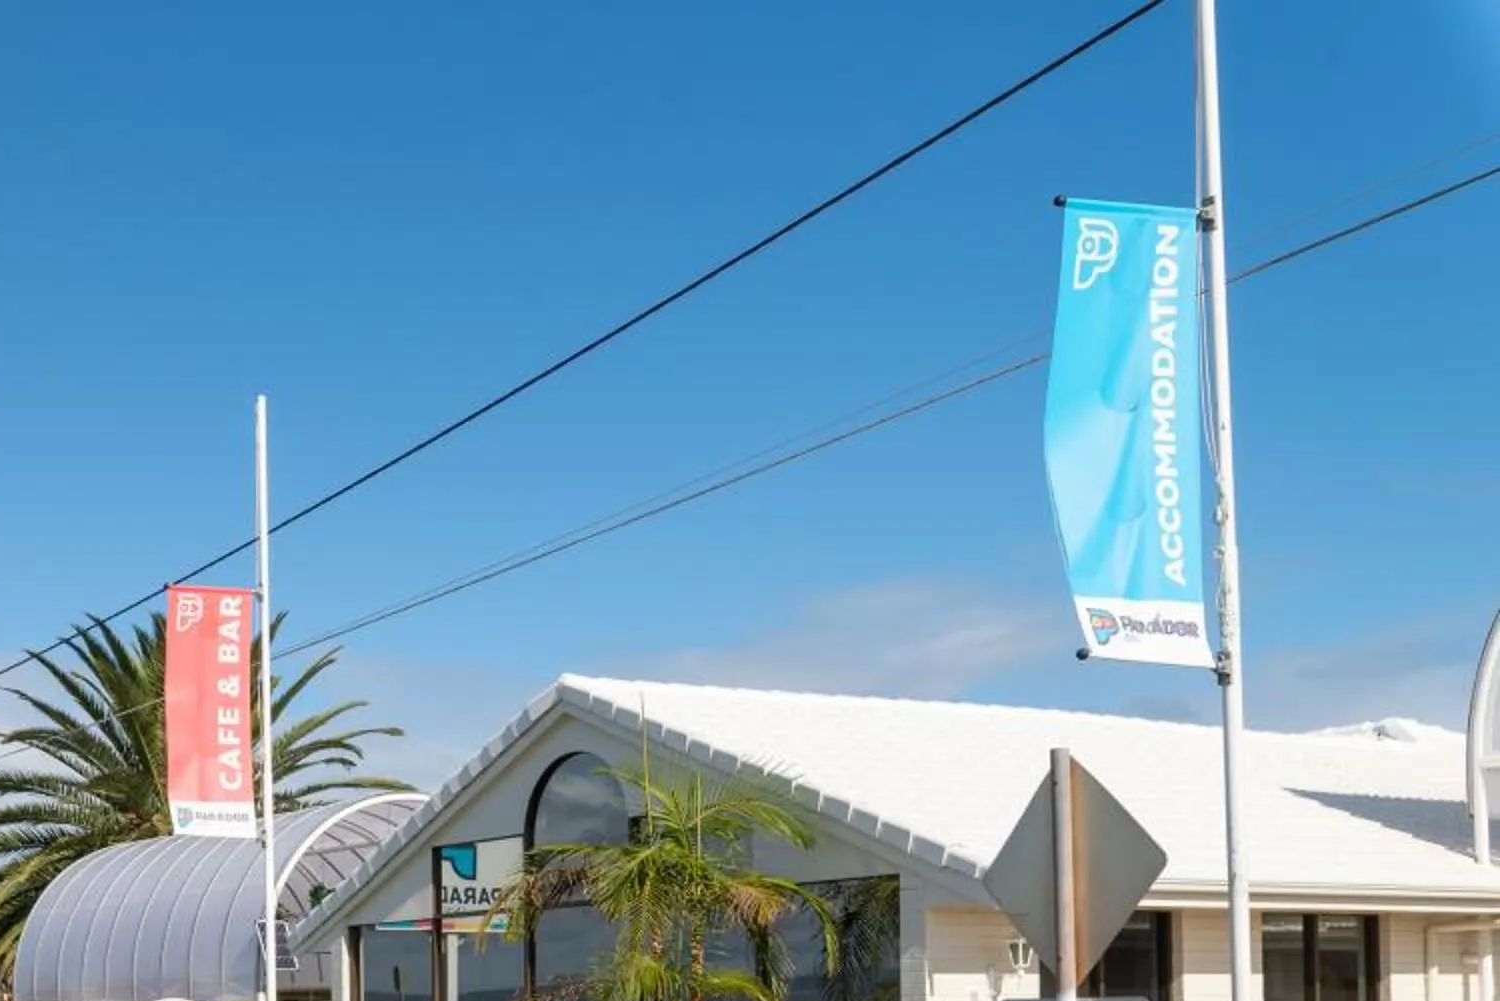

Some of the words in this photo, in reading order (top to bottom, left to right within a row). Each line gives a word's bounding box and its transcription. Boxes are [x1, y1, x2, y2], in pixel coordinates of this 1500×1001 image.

[1149, 224, 1187, 588] ACCOMMODATION
[217, 594, 243, 665] BAR
[217, 675, 241, 698] &
[217, 706, 243, 791] CAFE
